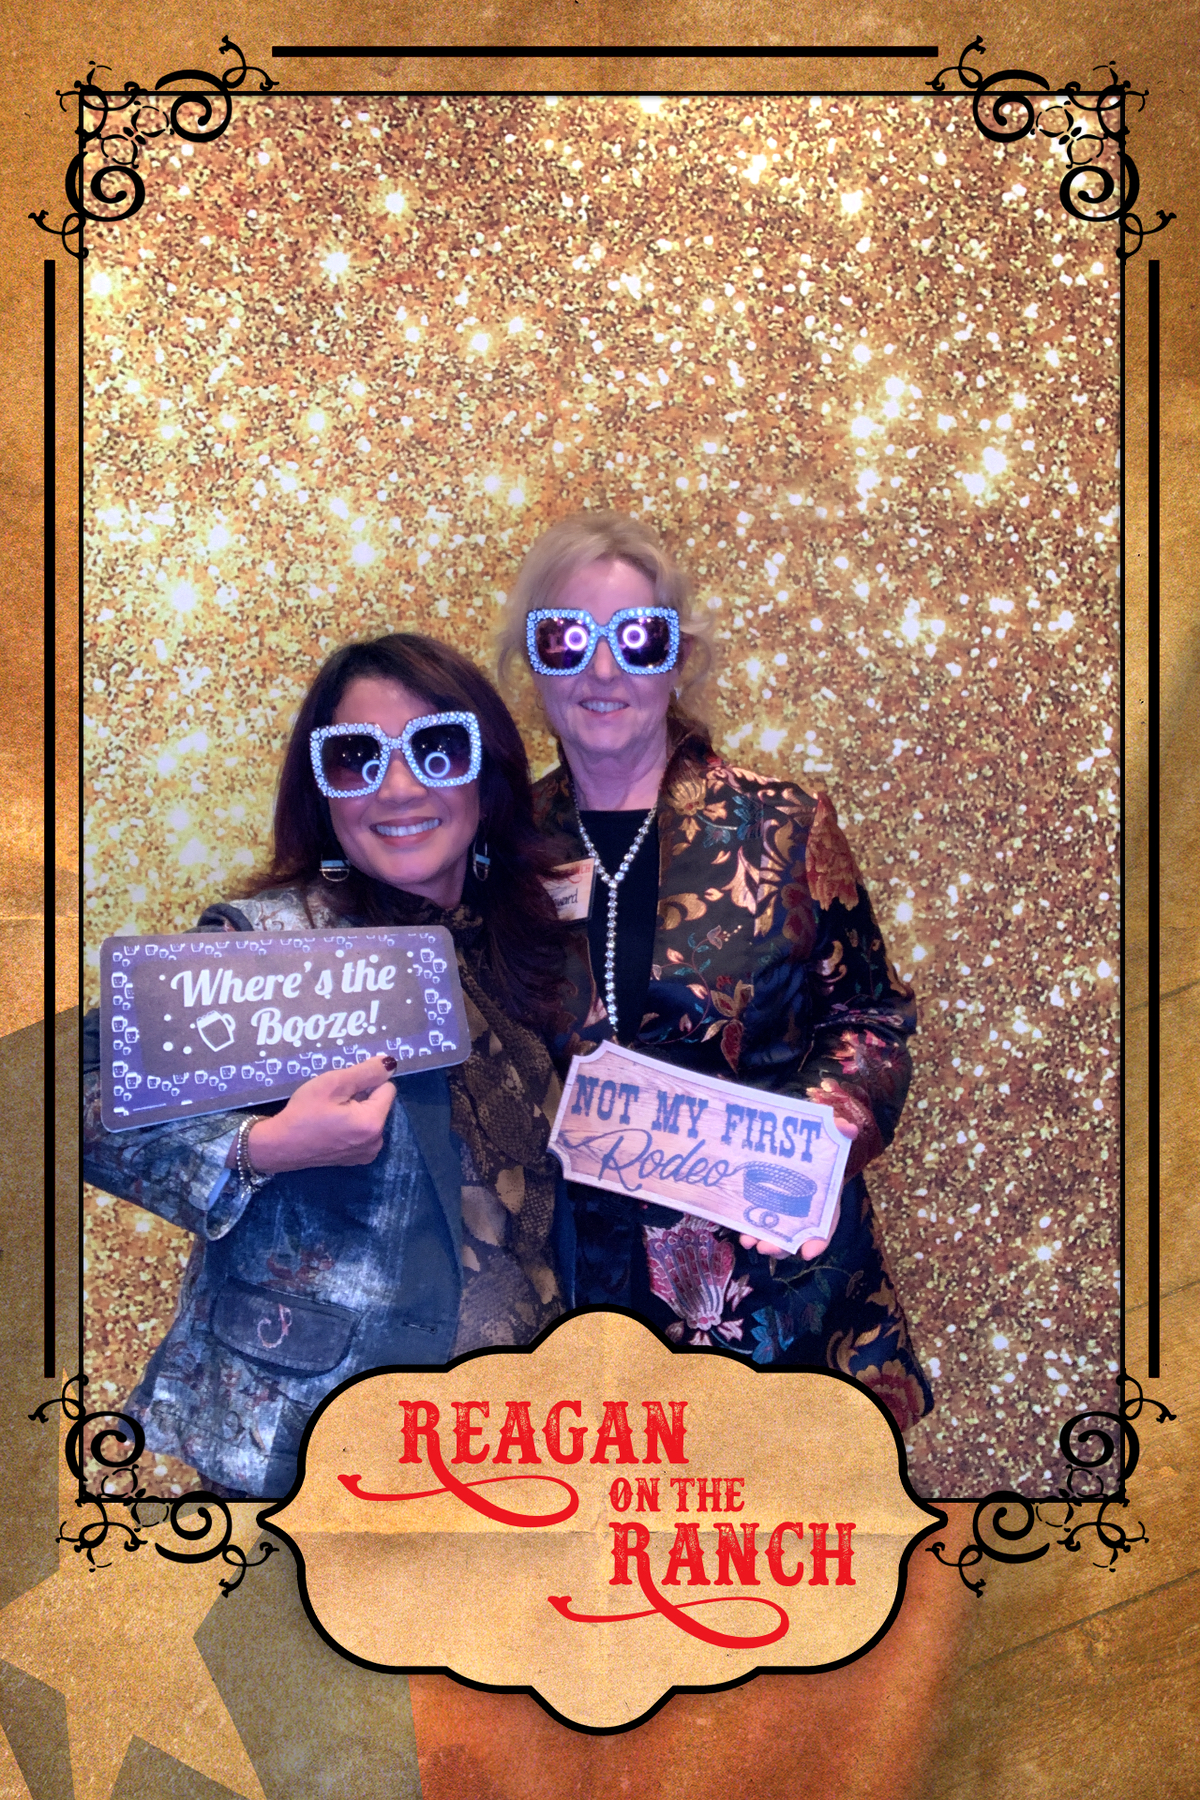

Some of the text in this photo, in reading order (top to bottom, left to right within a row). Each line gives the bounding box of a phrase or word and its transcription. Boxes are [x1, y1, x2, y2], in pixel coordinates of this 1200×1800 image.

[170, 958, 397, 1008] Where's the
[251, 1000, 380, 1046] Booze!
[571, 1074, 822, 1164] NOT MY FIRST
[559, 1128, 738, 1193] Rodeo
